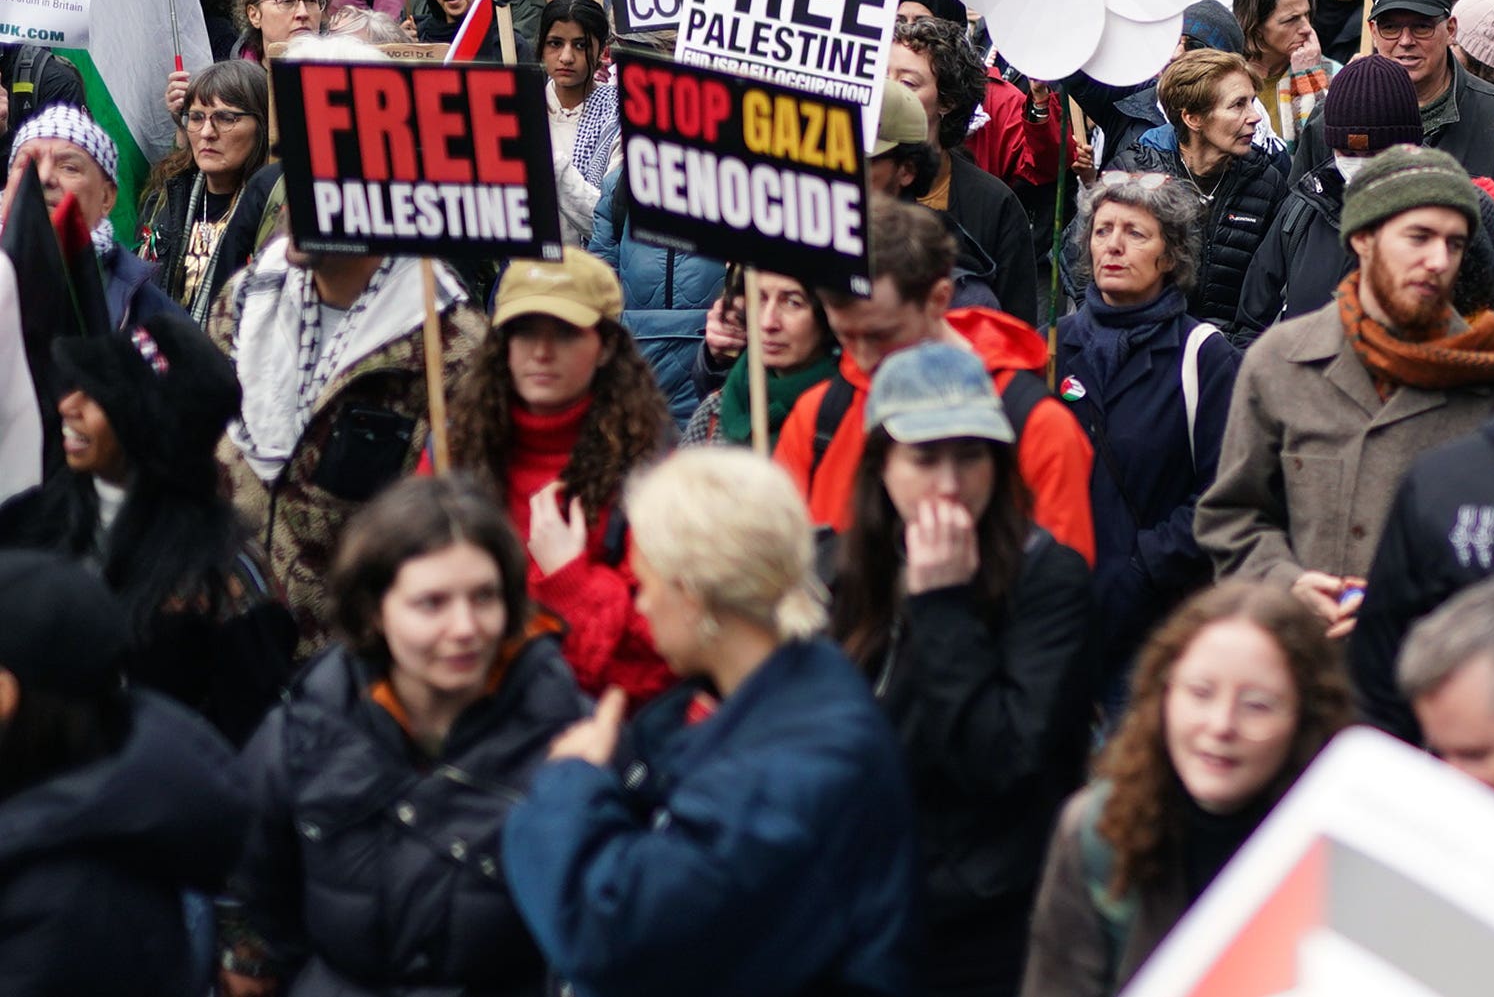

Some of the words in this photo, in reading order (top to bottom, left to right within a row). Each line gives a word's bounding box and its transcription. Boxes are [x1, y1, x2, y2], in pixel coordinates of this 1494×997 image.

[52, 0, 83, 12] Britain
[685, 7, 880, 81] PALESTINE
[302, 64, 528, 186] FREE
[623, 62, 733, 144] STOP
[741, 89, 858, 174] GAZA
[312, 181, 533, 242] PALESTINE
[626, 135, 865, 259] GENOCIDE
